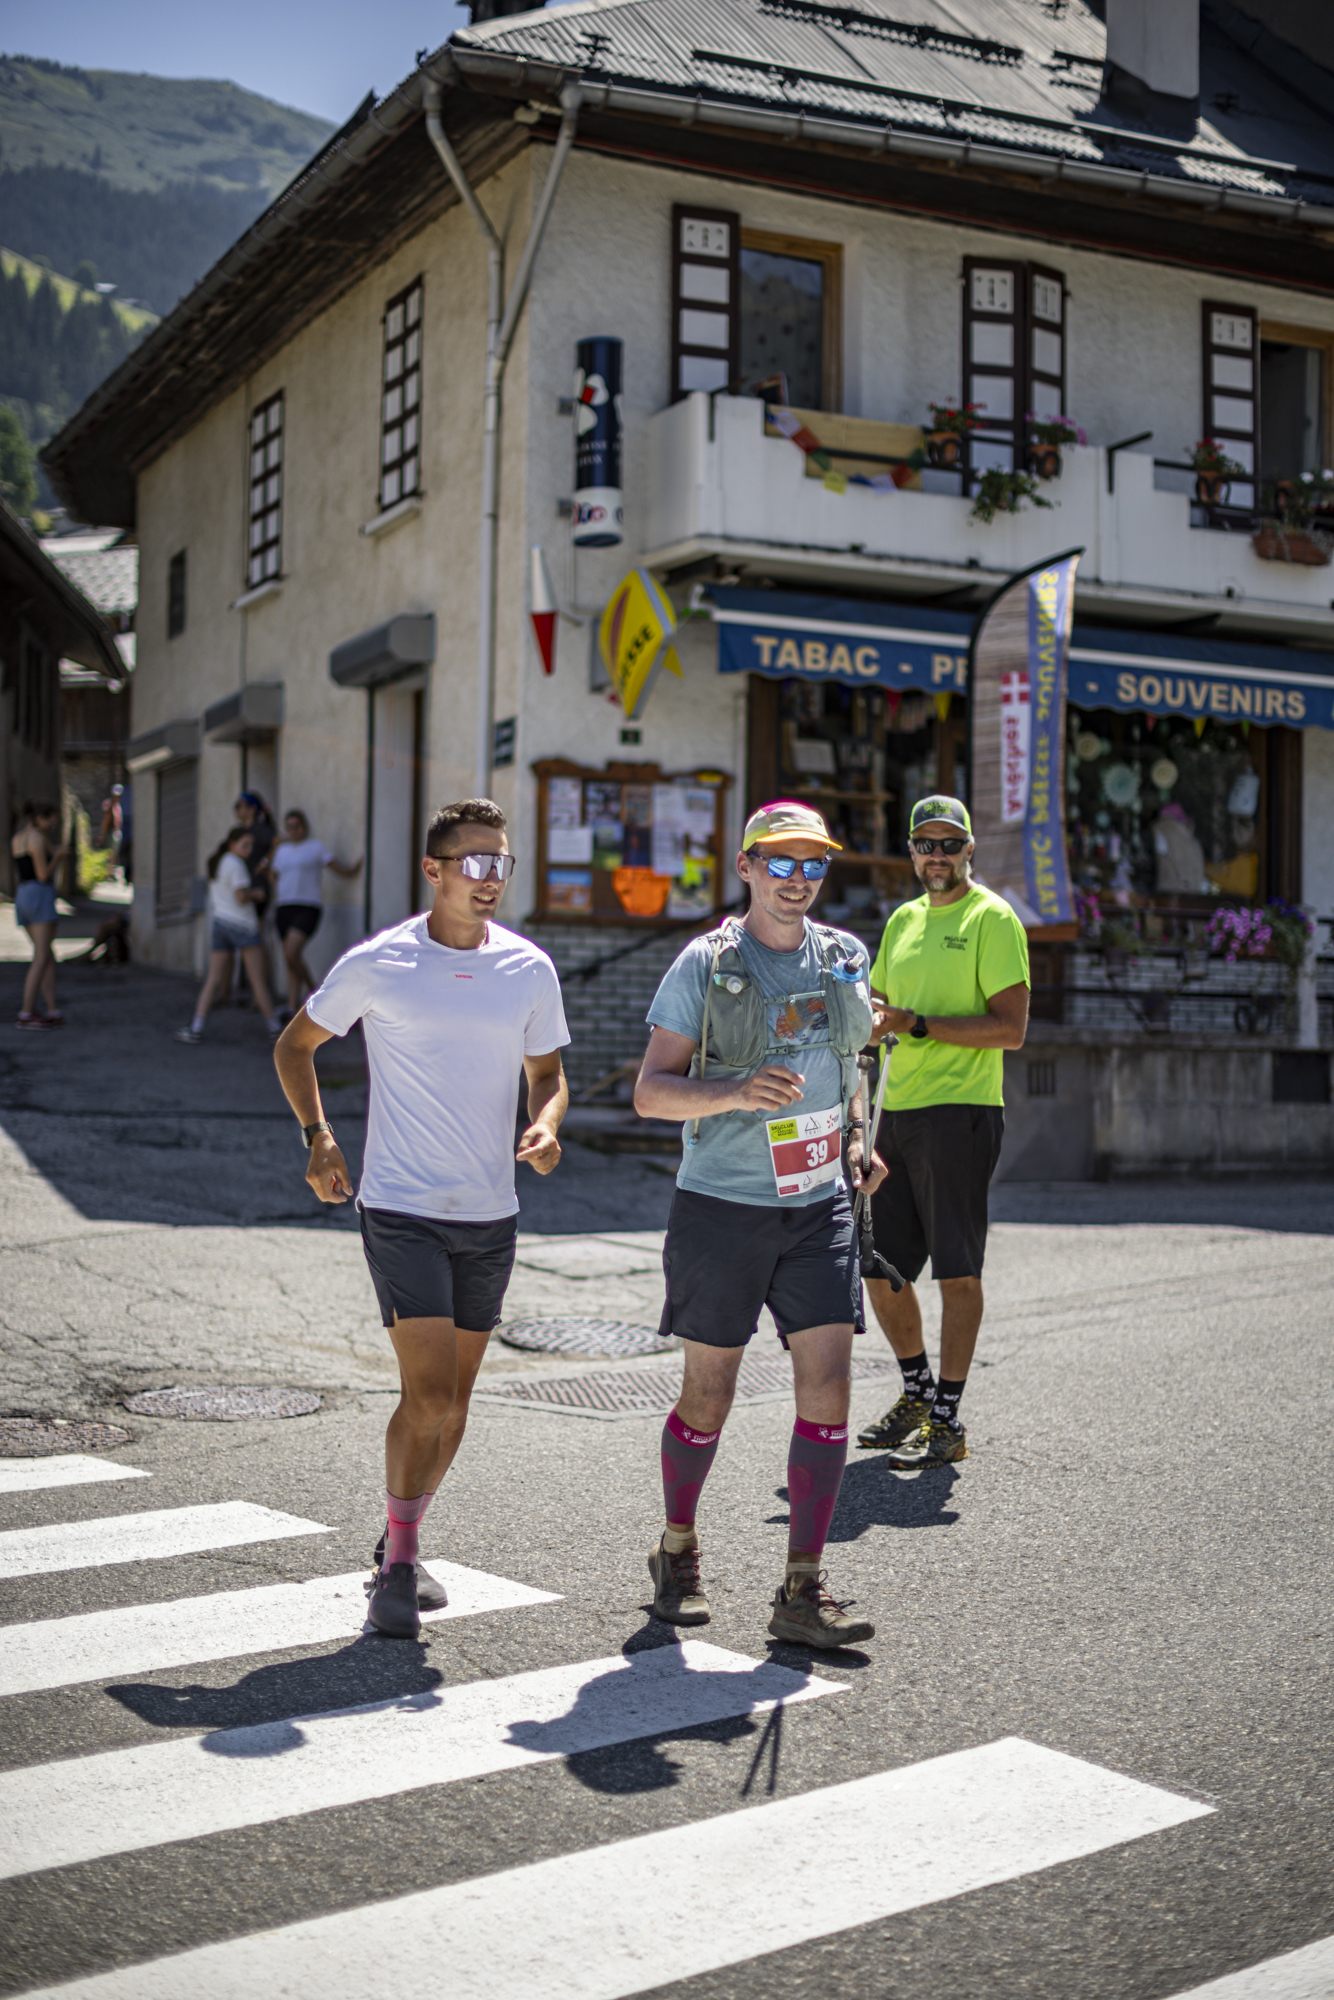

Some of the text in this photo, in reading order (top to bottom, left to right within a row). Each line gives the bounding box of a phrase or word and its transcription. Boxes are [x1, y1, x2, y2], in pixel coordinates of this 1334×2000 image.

[753, 635, 881, 677] TABAC
[1116, 671, 1307, 721] SOUVENIRS
[806, 1139, 828, 1168] 39
